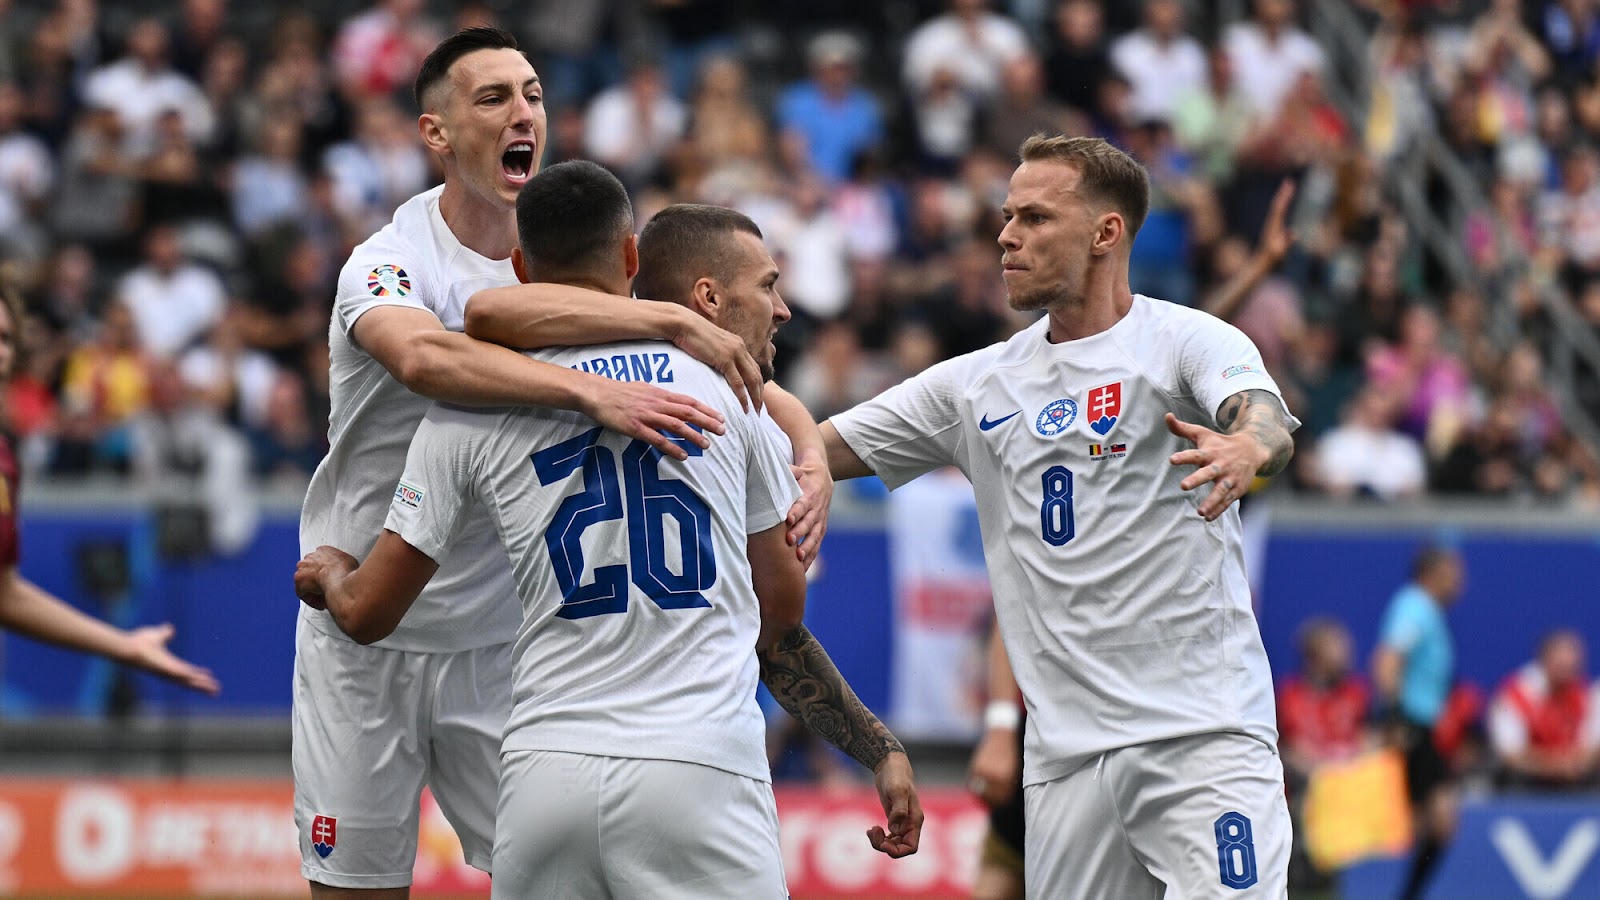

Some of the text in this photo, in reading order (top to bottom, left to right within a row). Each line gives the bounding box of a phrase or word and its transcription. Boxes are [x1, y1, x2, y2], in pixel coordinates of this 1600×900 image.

[529, 422, 717, 620] 26
[1041, 465, 1075, 546] 8
[1213, 811, 1258, 890] 8
